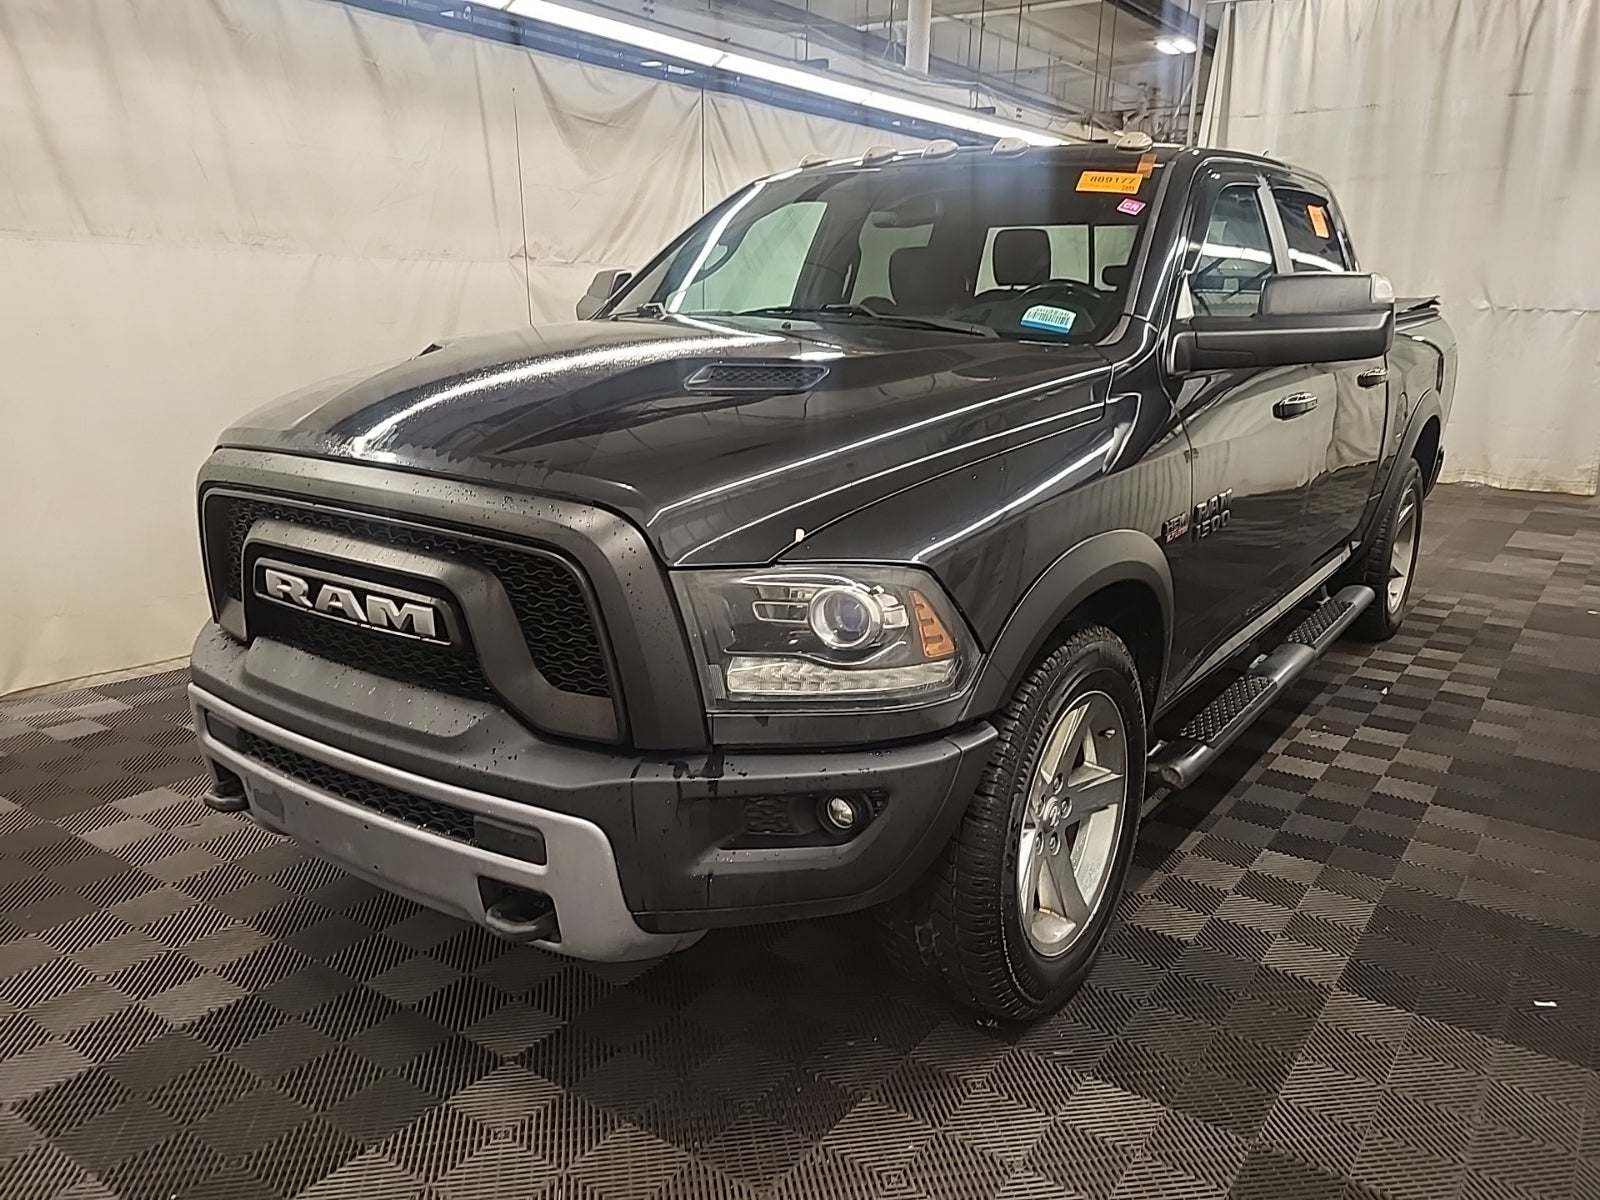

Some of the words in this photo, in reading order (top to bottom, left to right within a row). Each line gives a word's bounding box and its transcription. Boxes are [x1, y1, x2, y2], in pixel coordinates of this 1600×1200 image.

[1195, 488, 1232, 521] RAM
[1196, 509, 1231, 540] 1500
[265, 568, 437, 638] RAM
